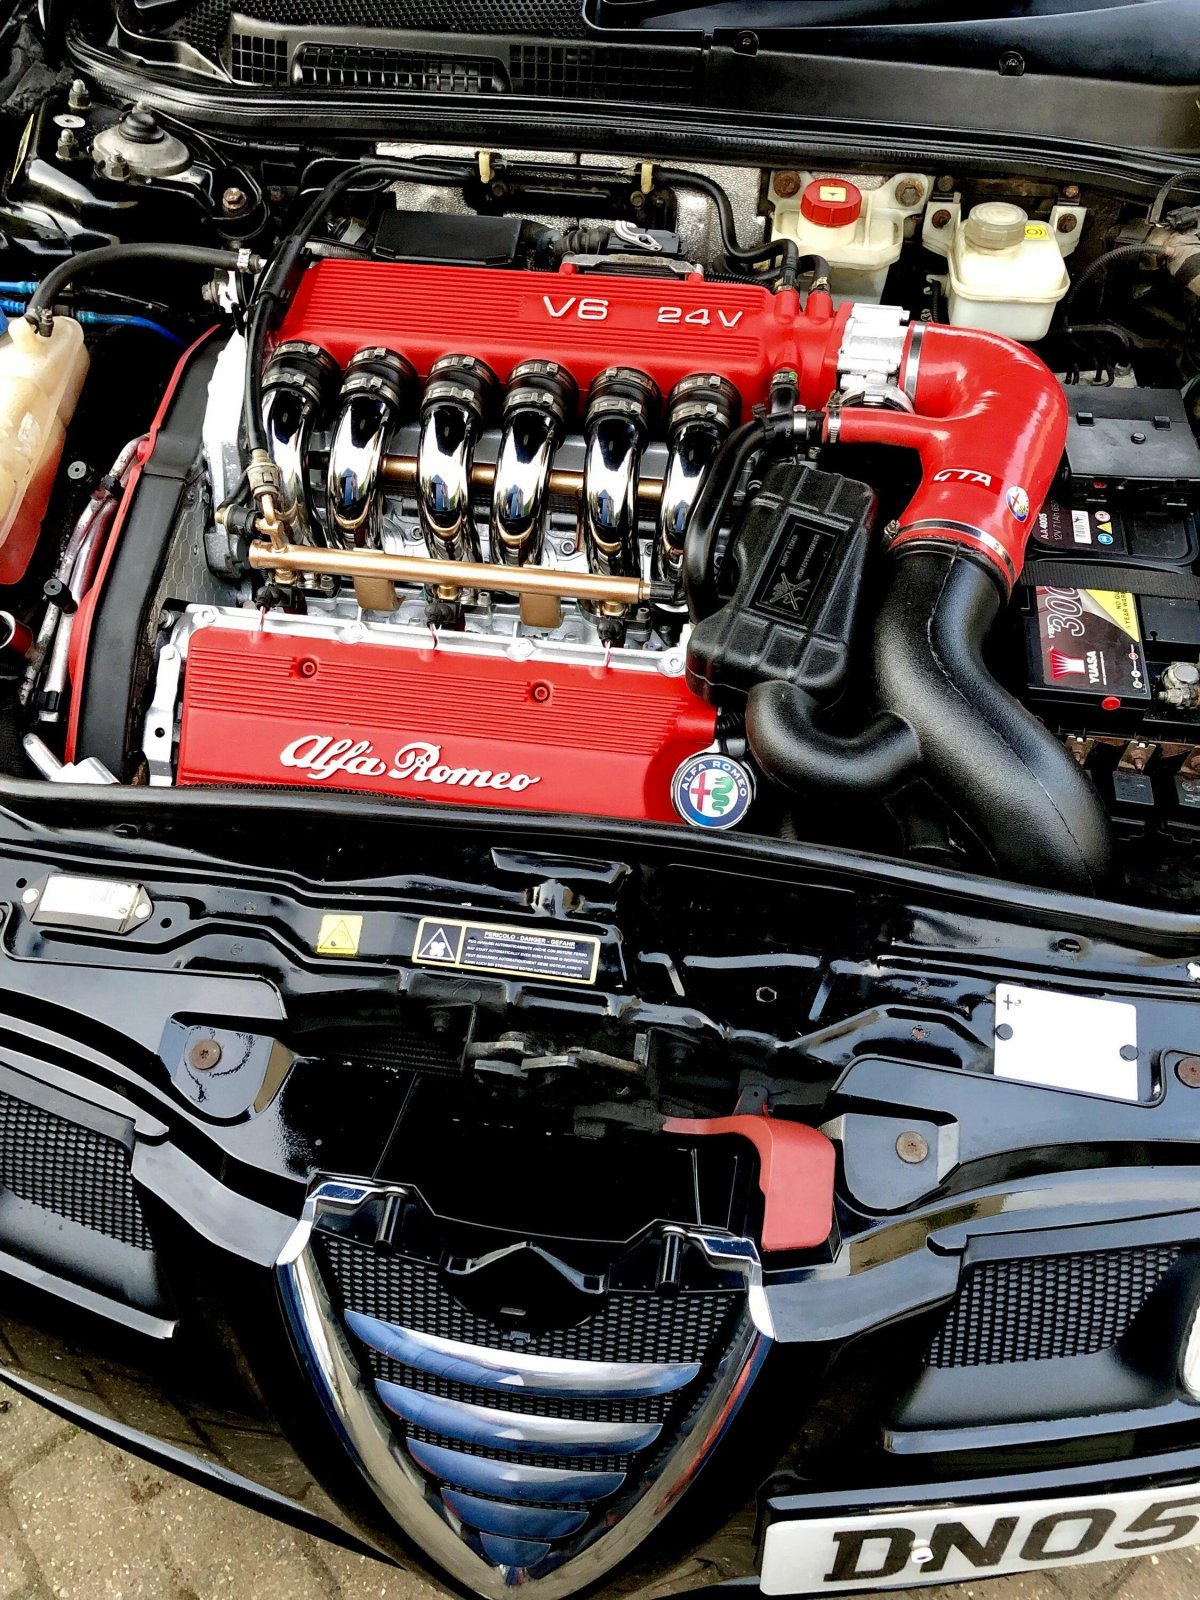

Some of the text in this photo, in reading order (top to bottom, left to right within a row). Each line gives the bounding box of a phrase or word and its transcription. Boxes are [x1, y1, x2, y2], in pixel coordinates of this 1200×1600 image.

[543, 296, 743, 328] V6 24V
[933, 469, 992, 487] GTA
[1054, 528, 1063, 540] 12V
[1124, 609, 1132, 624] YEAR
[1086, 650, 1100, 684] YUASA
[280, 735, 541, 791] Alfa Romeo
[682, 760, 747, 797] ALFA ROMEO
[483, 931, 515, 940] PERICOLO
[519, 935, 546, 943] DANGER
[550, 938, 576, 947] GEFAHR
